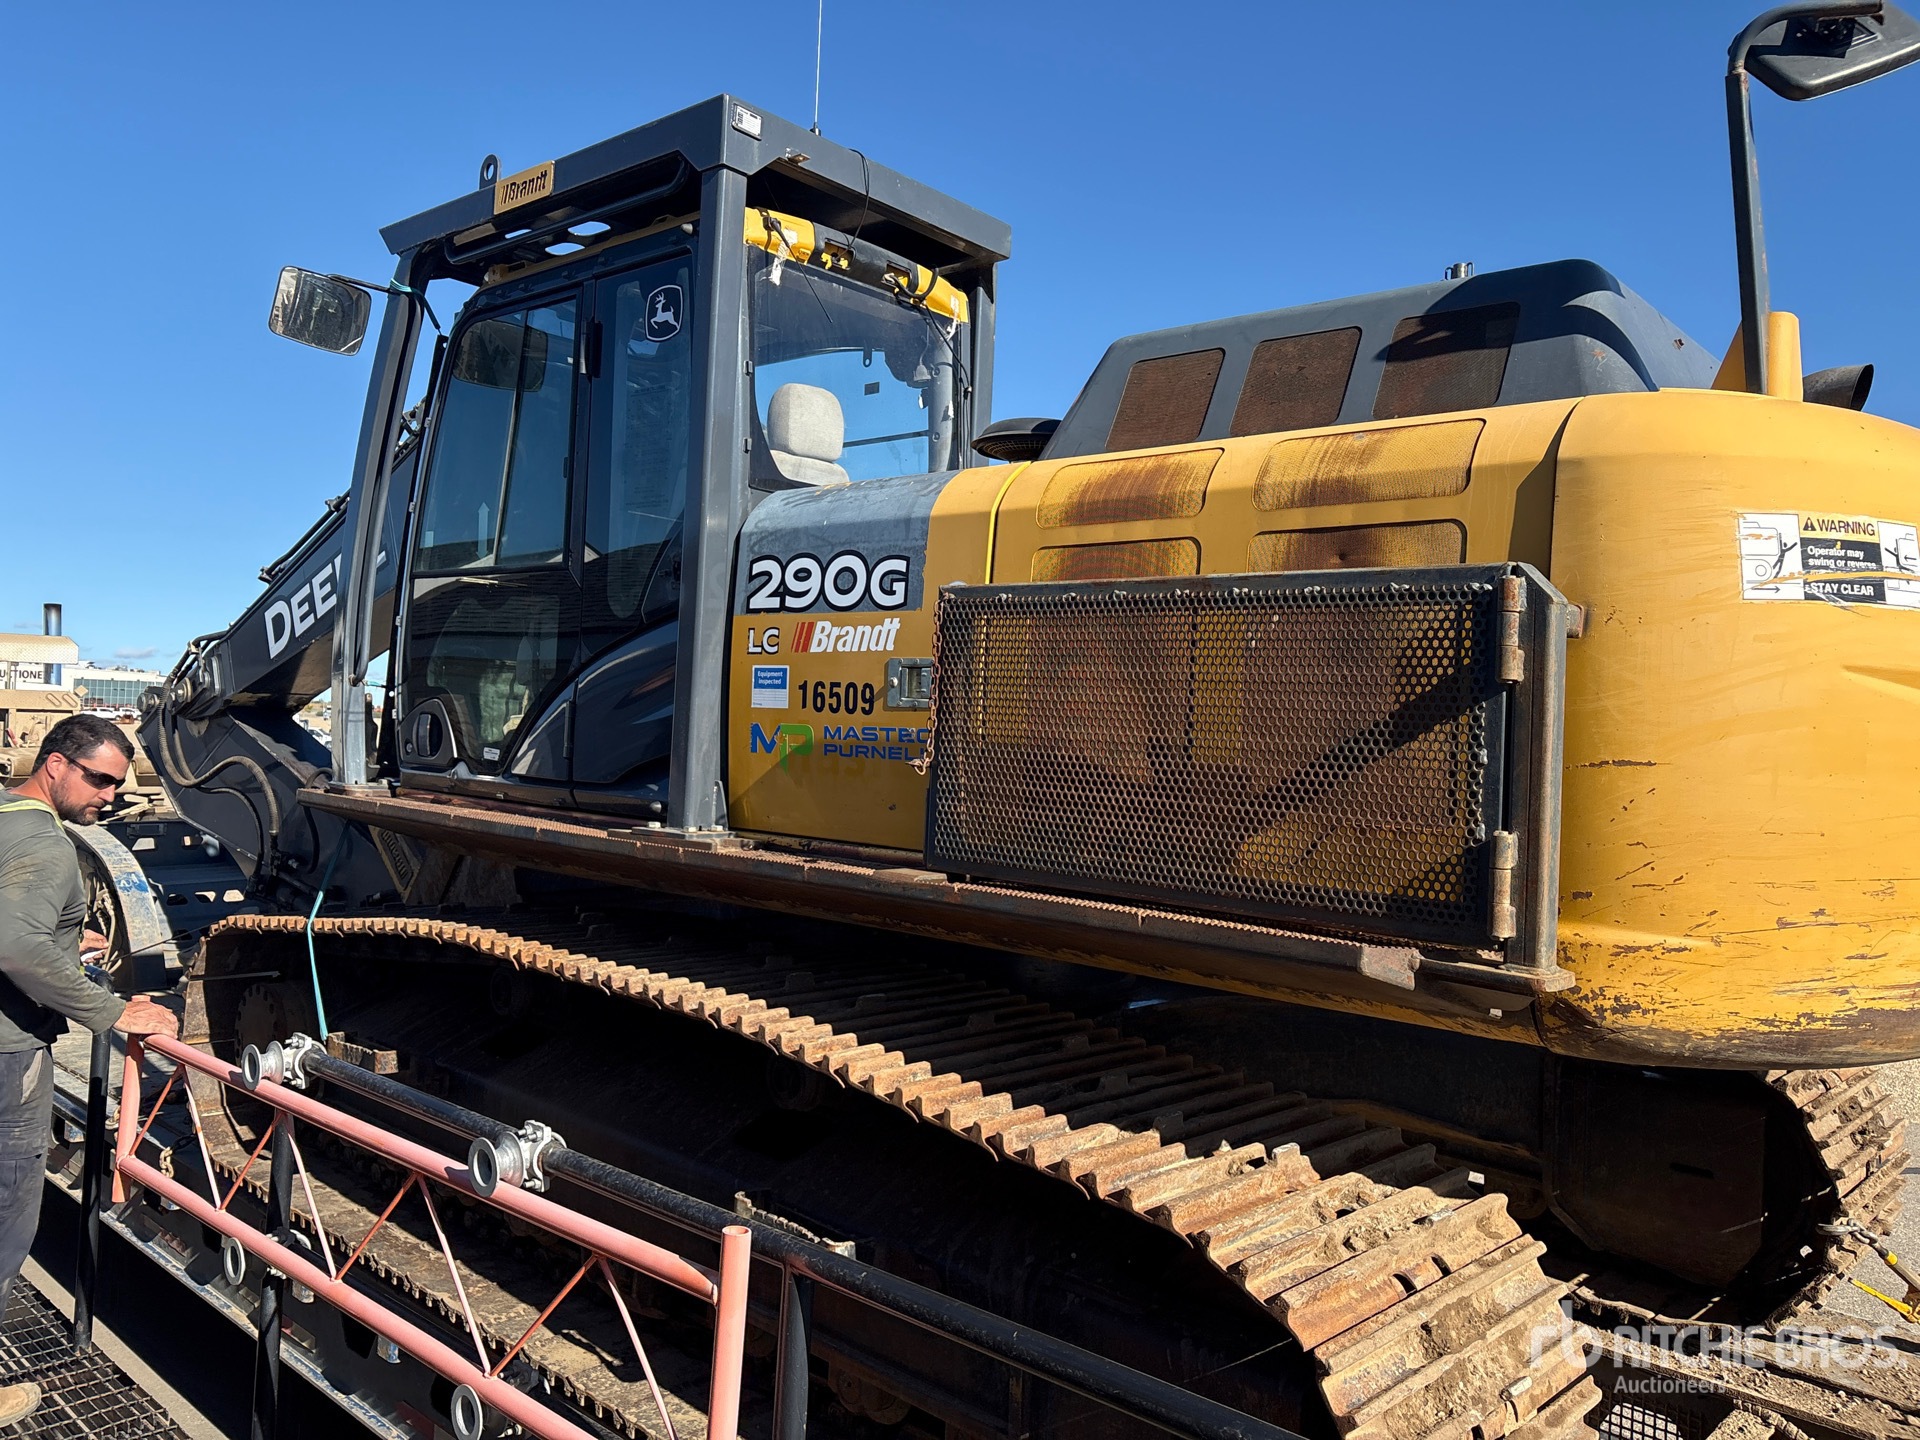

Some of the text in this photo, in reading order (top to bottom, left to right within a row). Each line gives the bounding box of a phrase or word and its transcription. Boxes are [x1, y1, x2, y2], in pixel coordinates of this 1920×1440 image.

[1816, 518, 1876, 536] WARNING
[1807, 545, 1864, 560] Operator may
[1808, 557, 1835, 569] swing
[747, 550, 910, 613] 290G
[1810, 582, 1875, 596] STAY CLEAR
[264, 550, 387, 660] DEE
[747, 617, 901, 655] LC Brandt
[757, 670, 783, 678] Equipment
[798, 680, 875, 716] 16509
